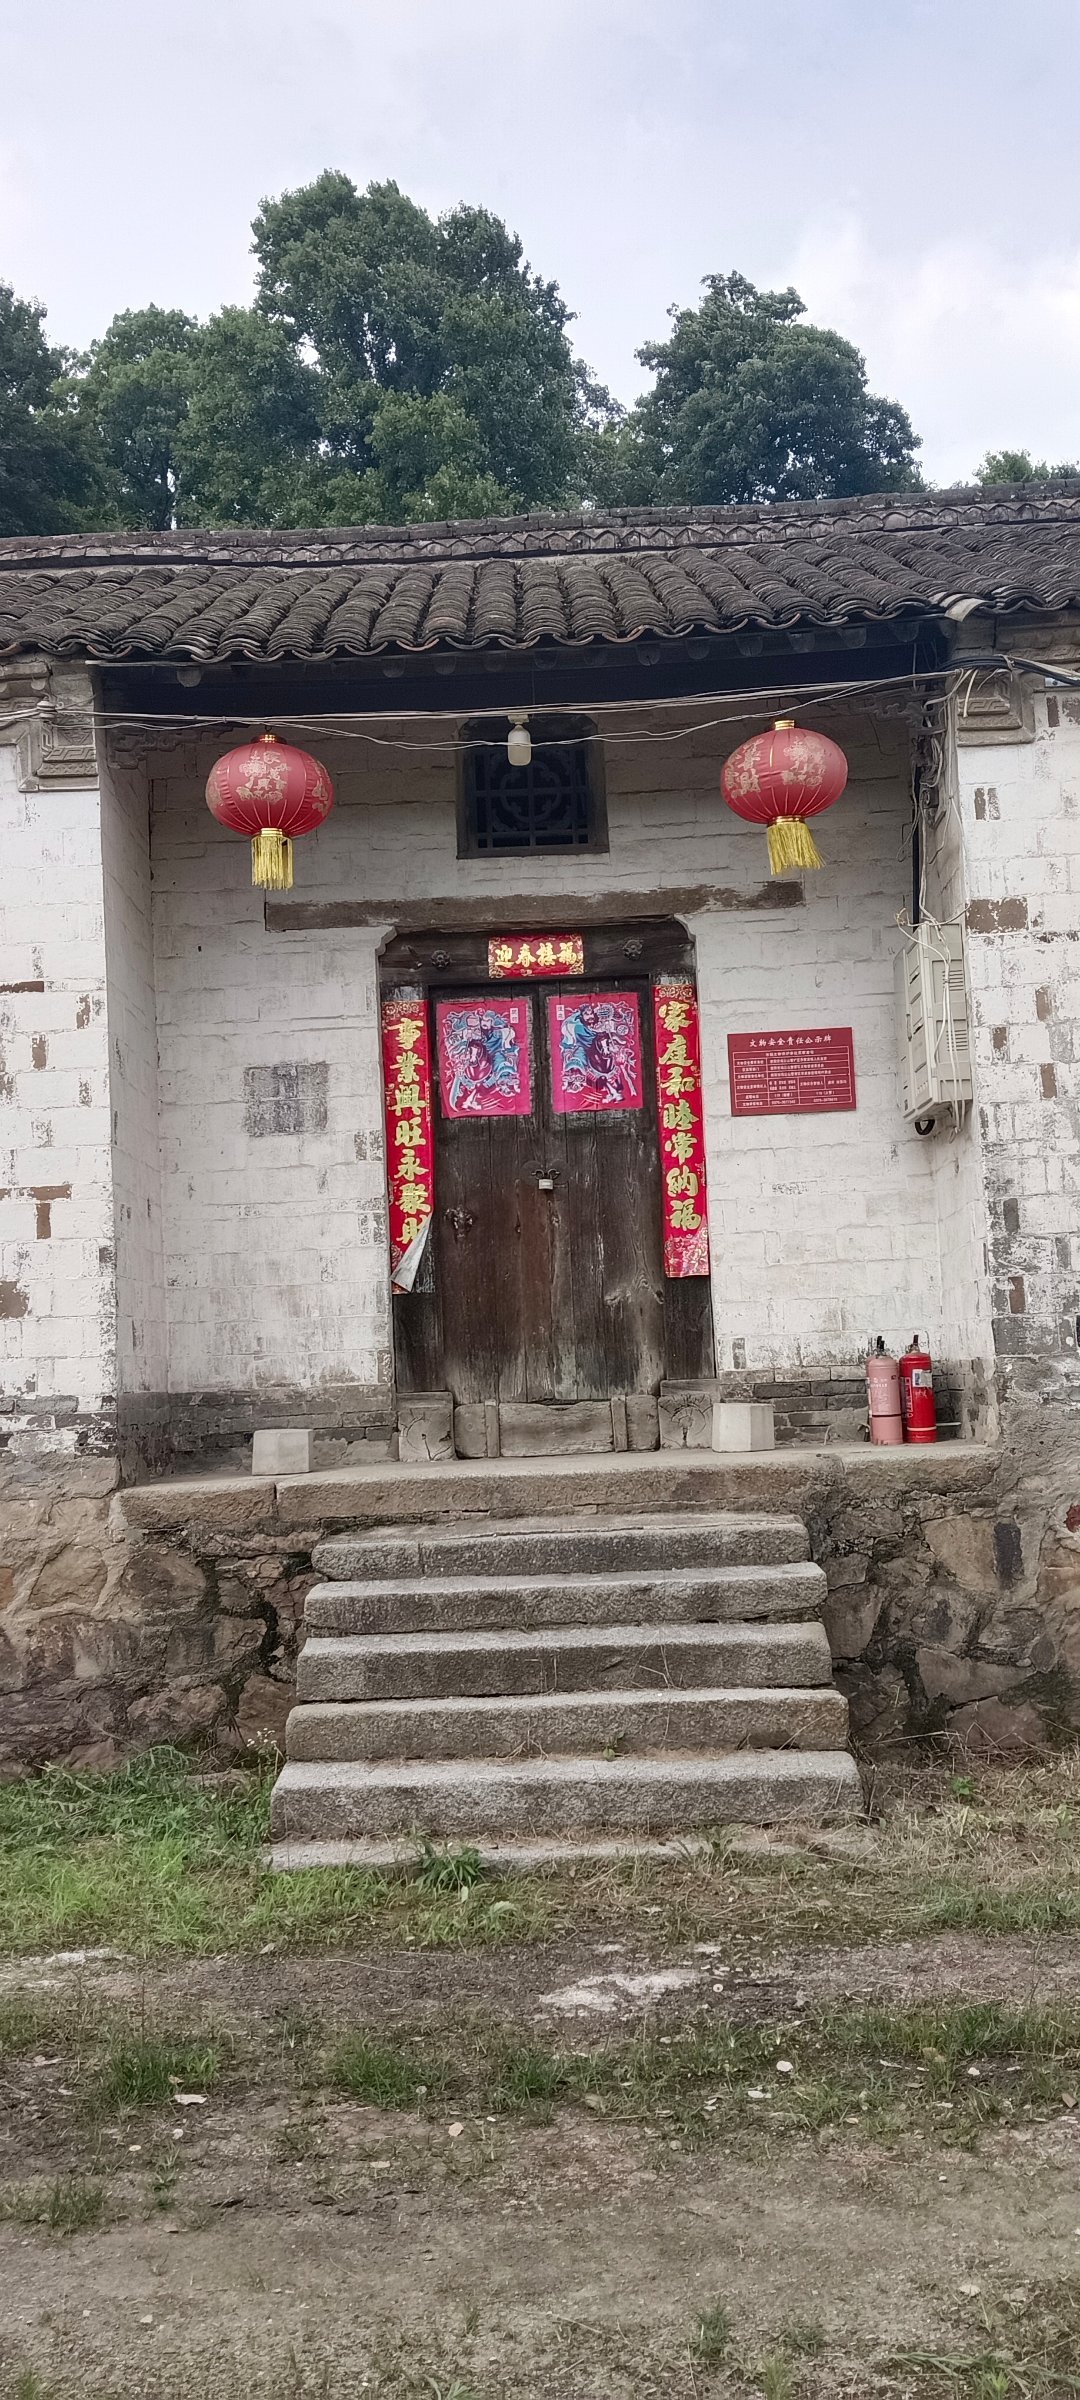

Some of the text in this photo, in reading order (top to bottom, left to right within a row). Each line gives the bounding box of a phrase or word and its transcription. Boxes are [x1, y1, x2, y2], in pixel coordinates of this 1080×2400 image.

[495, 942, 577, 968] 迎春接福
[658, 1001, 702, 1231] 家庭和睦常納福
